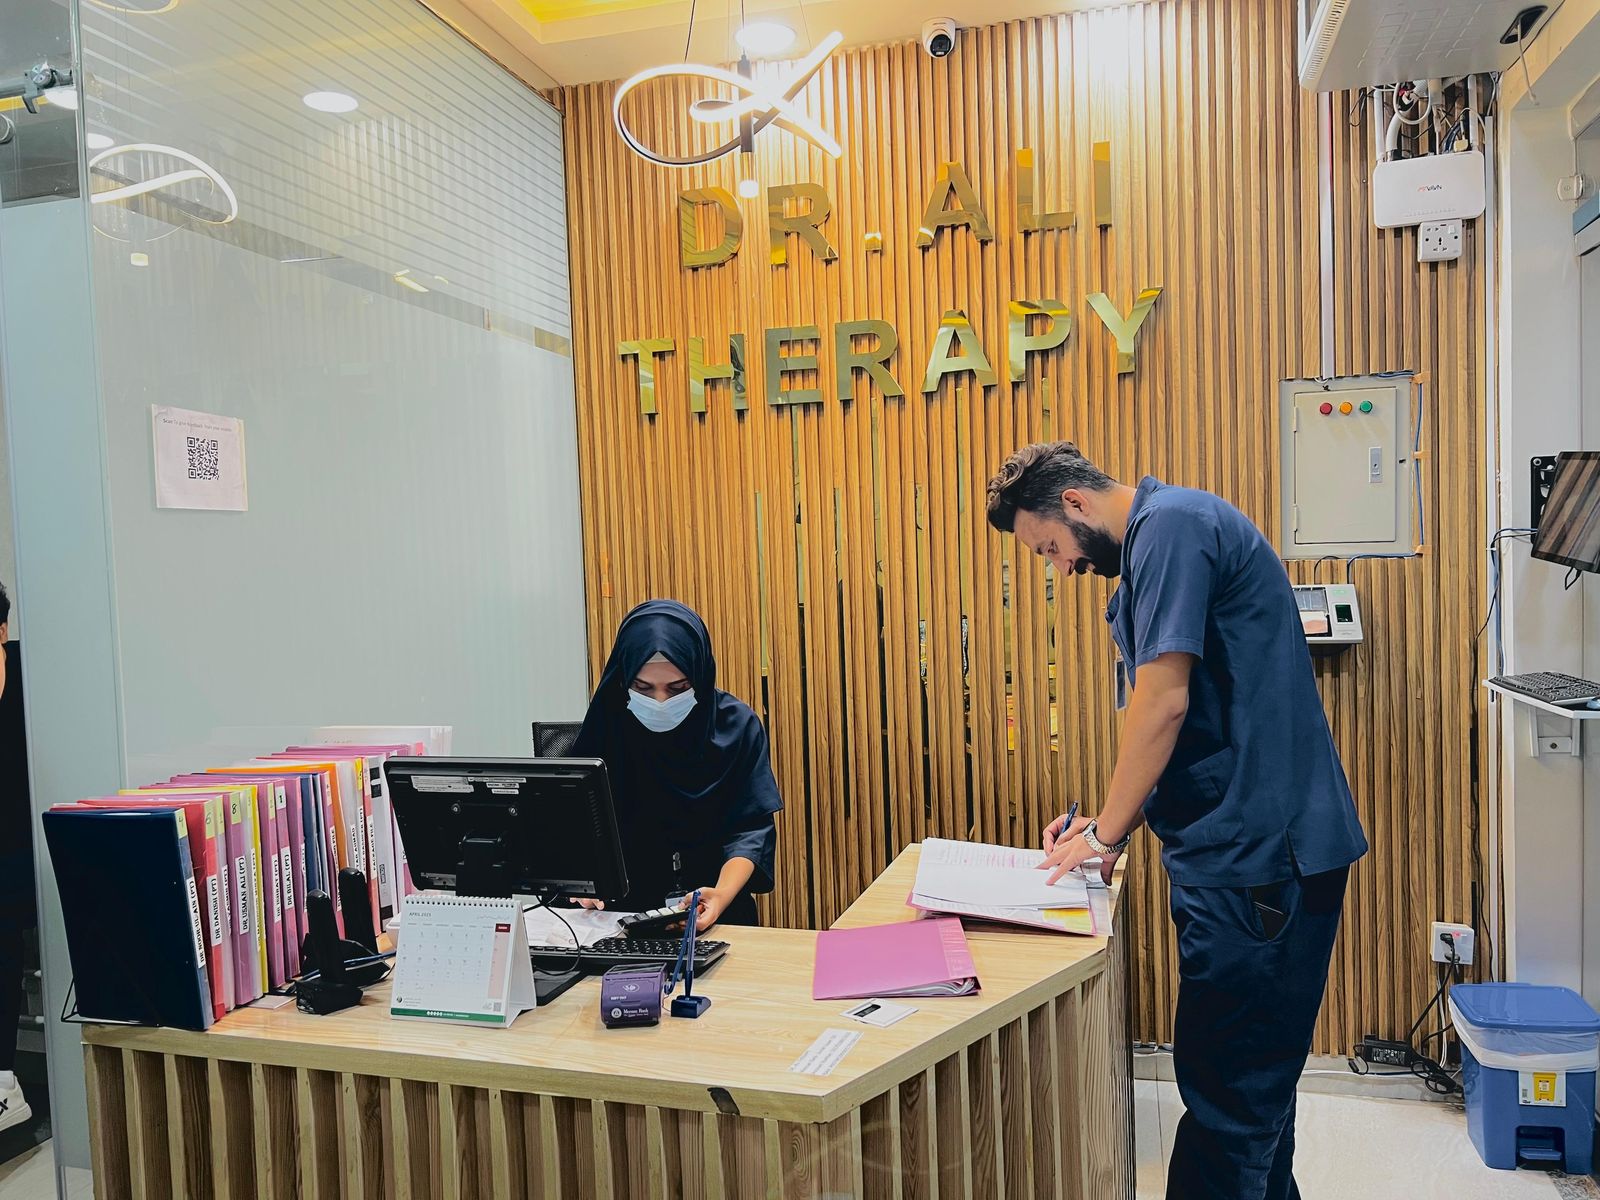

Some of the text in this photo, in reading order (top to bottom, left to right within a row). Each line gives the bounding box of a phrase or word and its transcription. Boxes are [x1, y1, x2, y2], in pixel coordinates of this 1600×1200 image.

[679, 141, 1112, 268] DR. ALI
[618, 287, 1163, 415] THERAPY
[232, 803, 237, 814] 8
[287, 894, 293, 905] DR
[243, 918, 248, 930] DR
[215, 927, 220, 939] DR
[199, 951, 205, 963] DR
